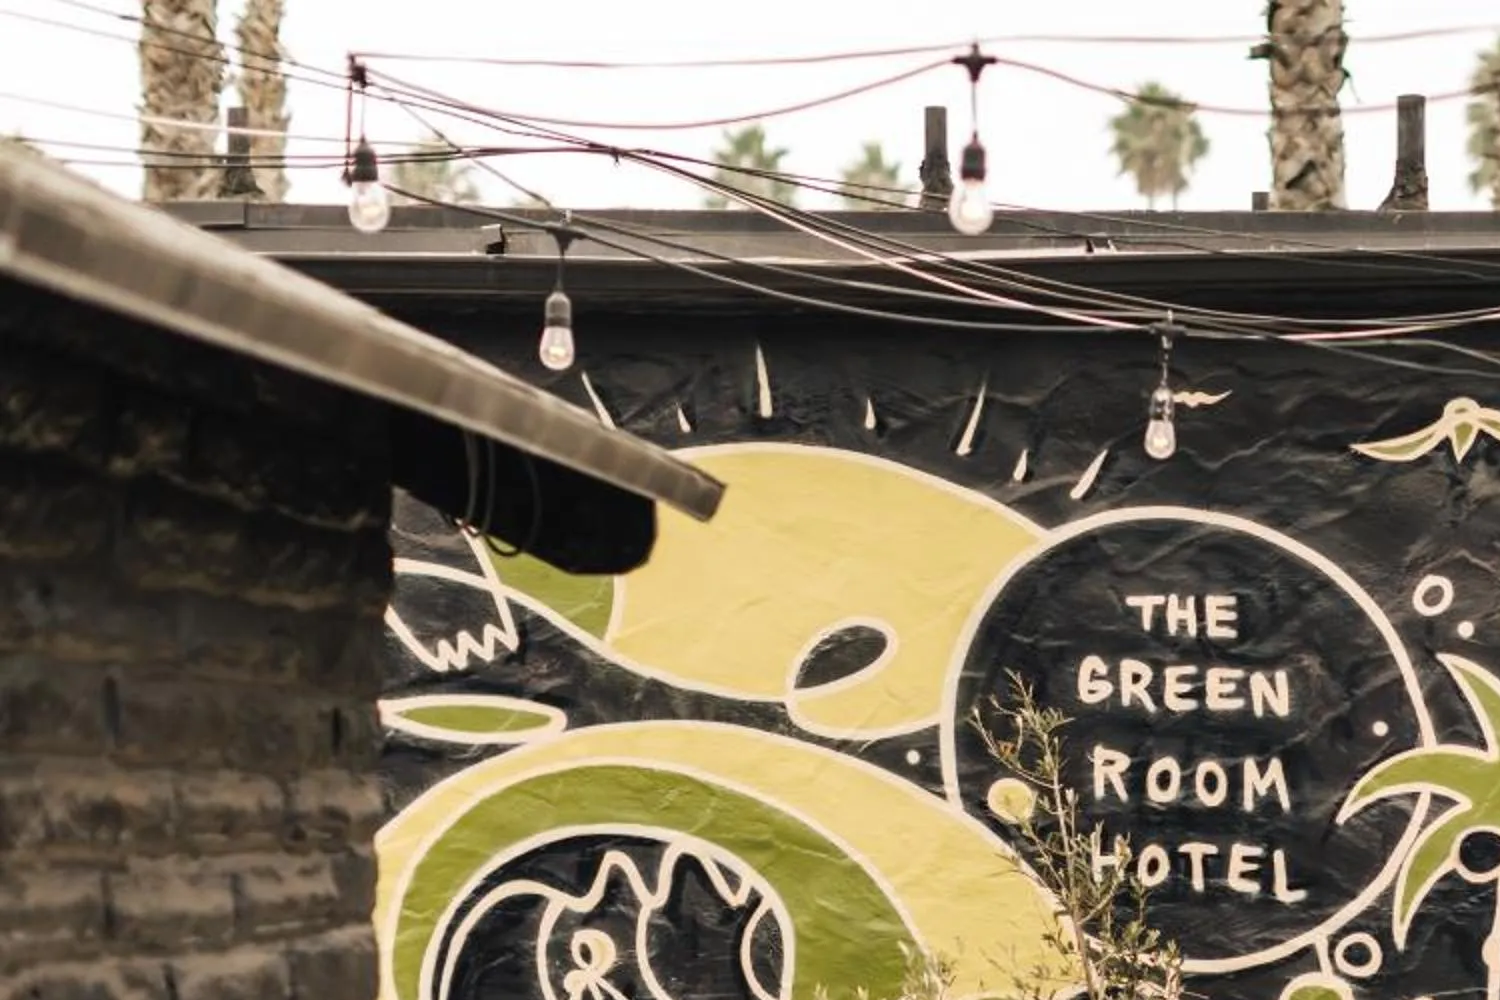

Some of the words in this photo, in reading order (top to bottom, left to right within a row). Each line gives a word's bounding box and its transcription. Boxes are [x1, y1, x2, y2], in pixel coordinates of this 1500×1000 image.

[1125, 593, 1238, 639] THE
[1077, 655, 1291, 718] GREEN
[1091, 745, 1291, 813] ROOM
[1092, 832, 1308, 902] HOTEL
